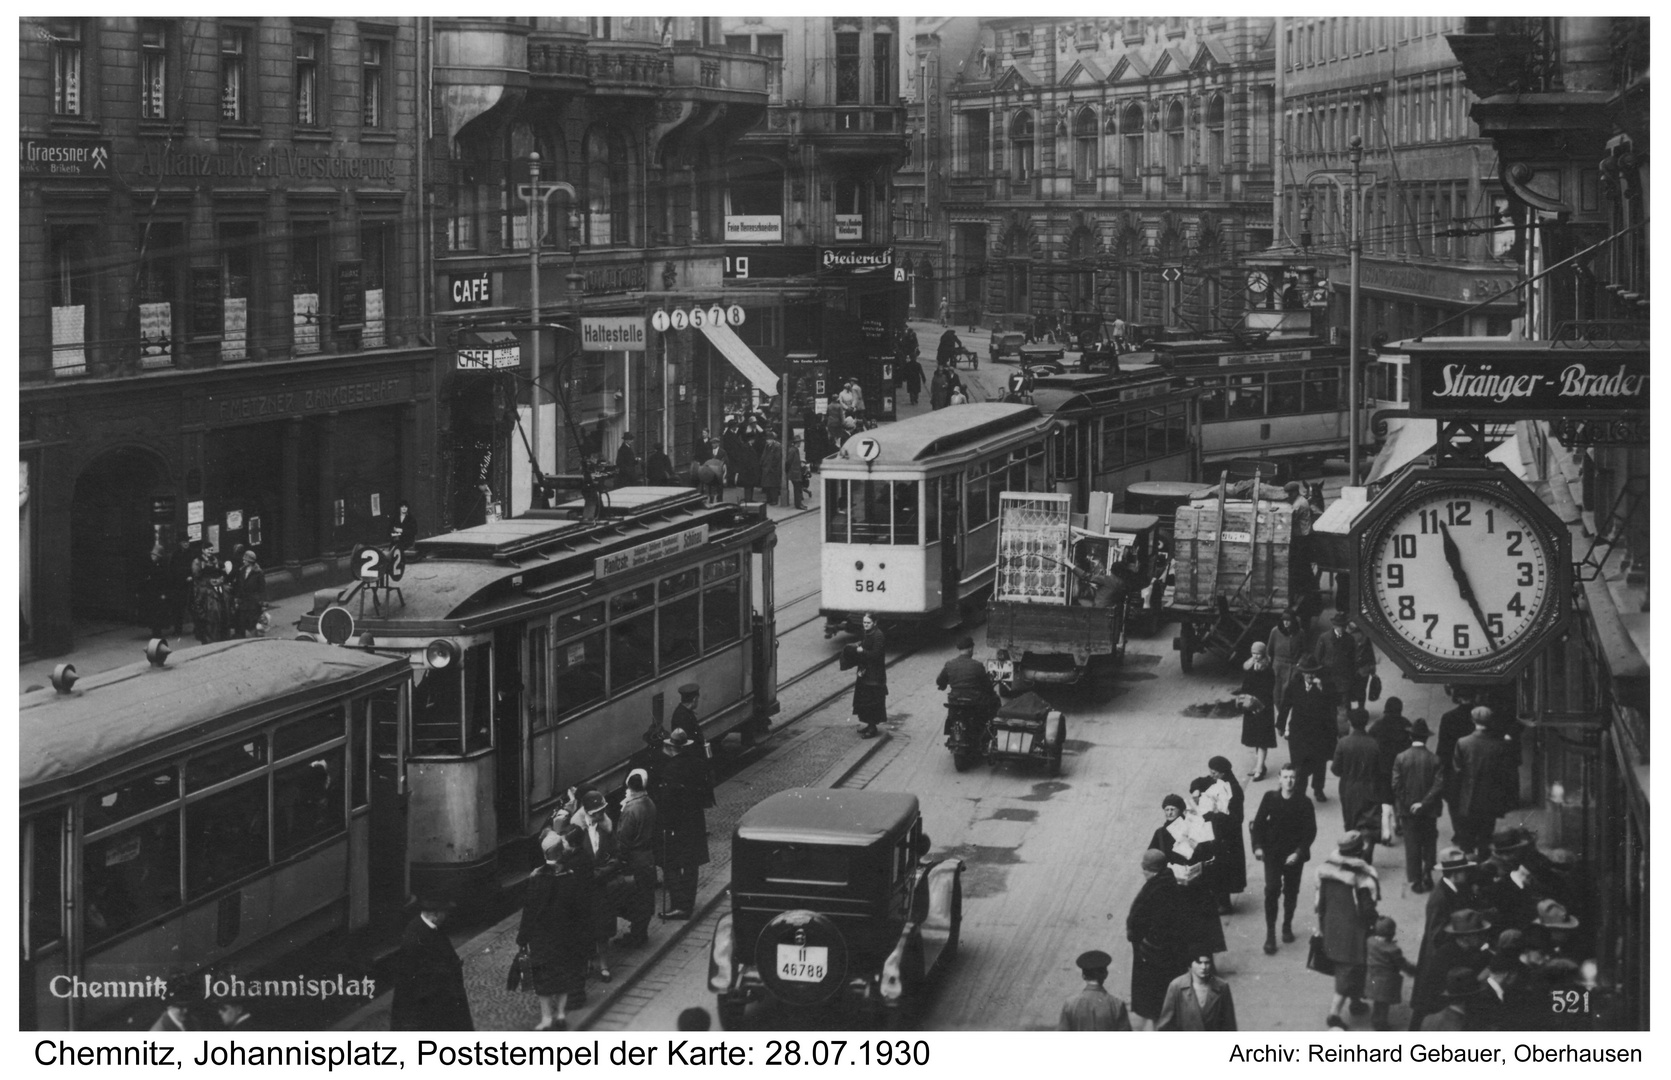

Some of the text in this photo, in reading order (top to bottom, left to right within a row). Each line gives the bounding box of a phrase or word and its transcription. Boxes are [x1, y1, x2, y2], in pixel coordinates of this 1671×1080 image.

[27, 141, 89, 162] Graessner
[139, 142, 212, 177] Allianz
[285, 146, 396, 185] Versicherung
[50, 163, 81, 175] Briketts
[453, 271, 489, 303] CAFÉ
[658, 307, 740, 330] 1 2 5 7 8
[585, 324, 643, 343] Haltestelle
[1013, 376, 1024, 392] 7
[1432, 363, 1545, 403] Stränger
[862, 441, 875, 458] 7
[1418, 509, 1439, 534] 11
[1446, 501, 1472, 526] 12
[1485, 509, 1495, 534] 1
[1392, 534, 1417, 559] 10
[1506, 531, 1523, 556] 2
[360, 549, 380, 578] 2
[393, 548, 402, 576] 2
[1516, 562, 1534, 587] 3
[856, 579, 886, 593] 584
[1387, 563, 1404, 588] 9
[1398, 595, 1416, 620] 8
[1507, 591, 1526, 617] 4
[1422, 614, 1439, 640] 7
[1453, 624, 1470, 649] 6
[1487, 613, 1504, 638] 5
[799, 949, 807, 962] II
[782, 963, 824, 979] 46788
